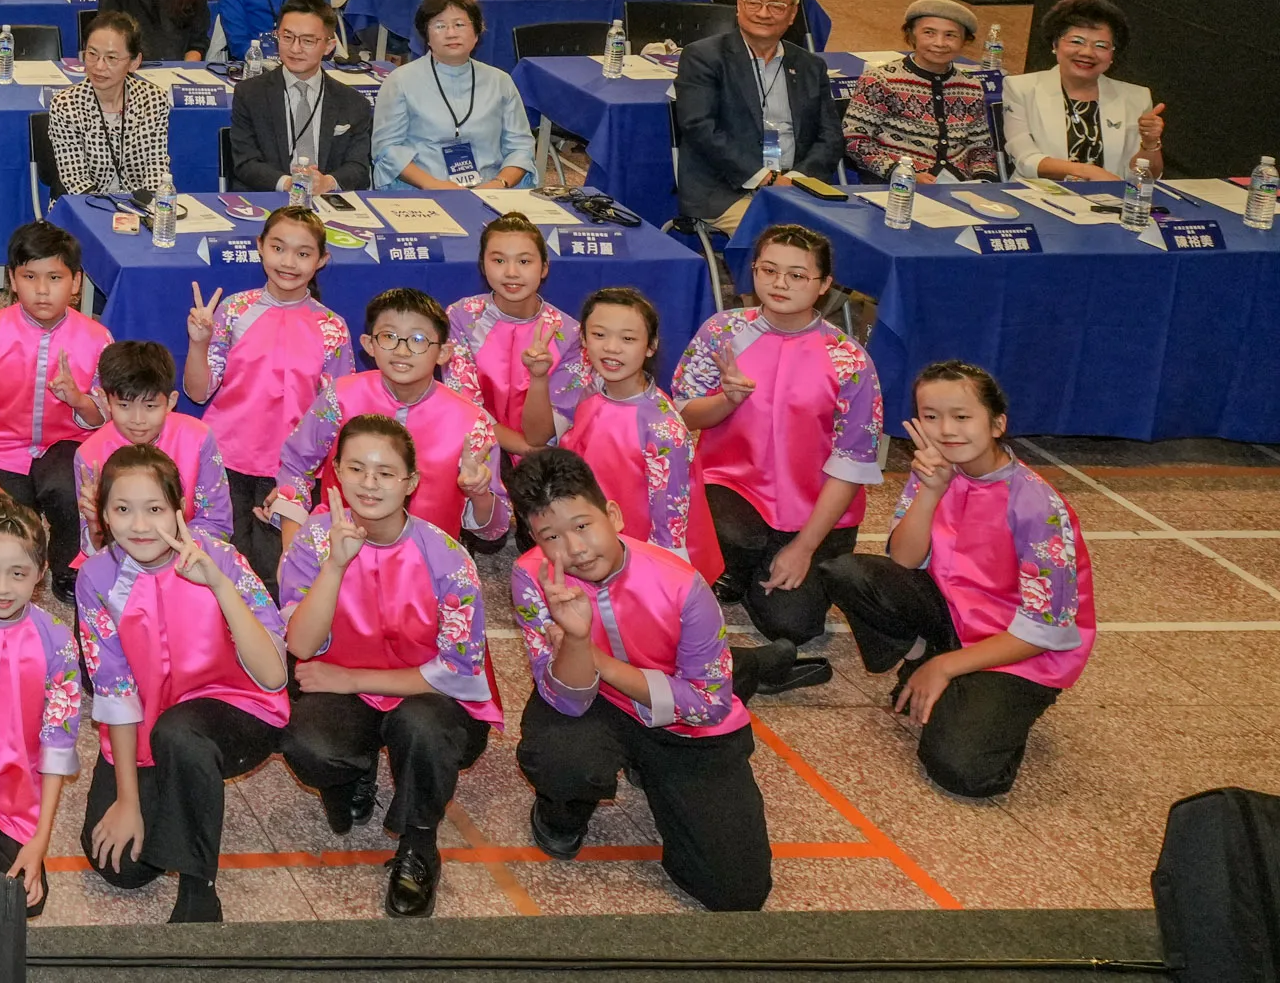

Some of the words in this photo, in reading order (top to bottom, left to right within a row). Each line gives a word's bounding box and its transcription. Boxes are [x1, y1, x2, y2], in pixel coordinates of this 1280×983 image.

[456, 174, 475, 183] VIP
[990, 237, 1030, 251] 張錦輝
[1175, 235, 1214, 249] 陳裕美
[390, 247, 430, 260] 向盛言
